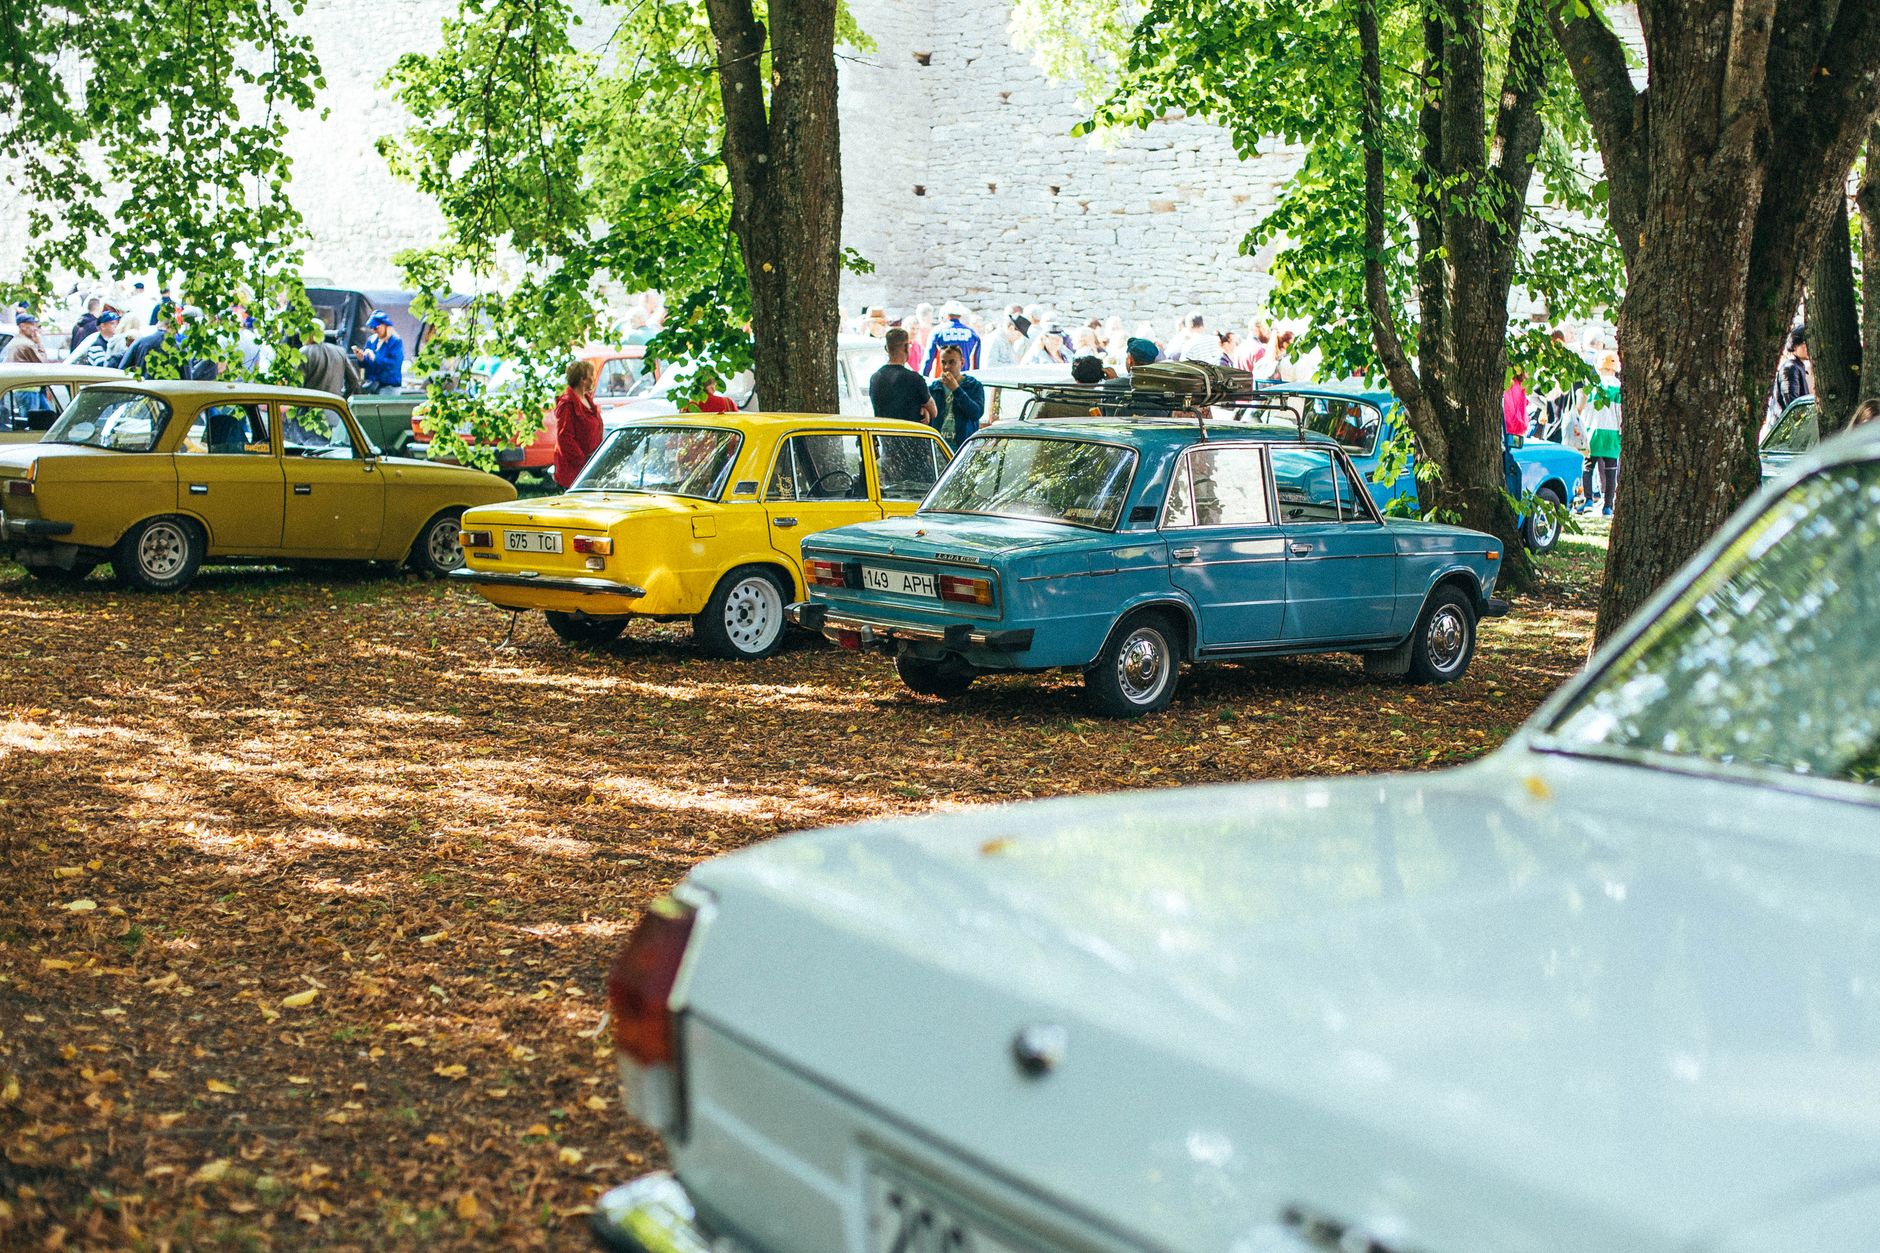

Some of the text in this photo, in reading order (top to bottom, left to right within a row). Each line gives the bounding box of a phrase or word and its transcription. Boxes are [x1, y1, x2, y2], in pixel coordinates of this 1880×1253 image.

[510, 533, 556, 551] 675 TCI
[868, 570, 933, 595] 149 APH
